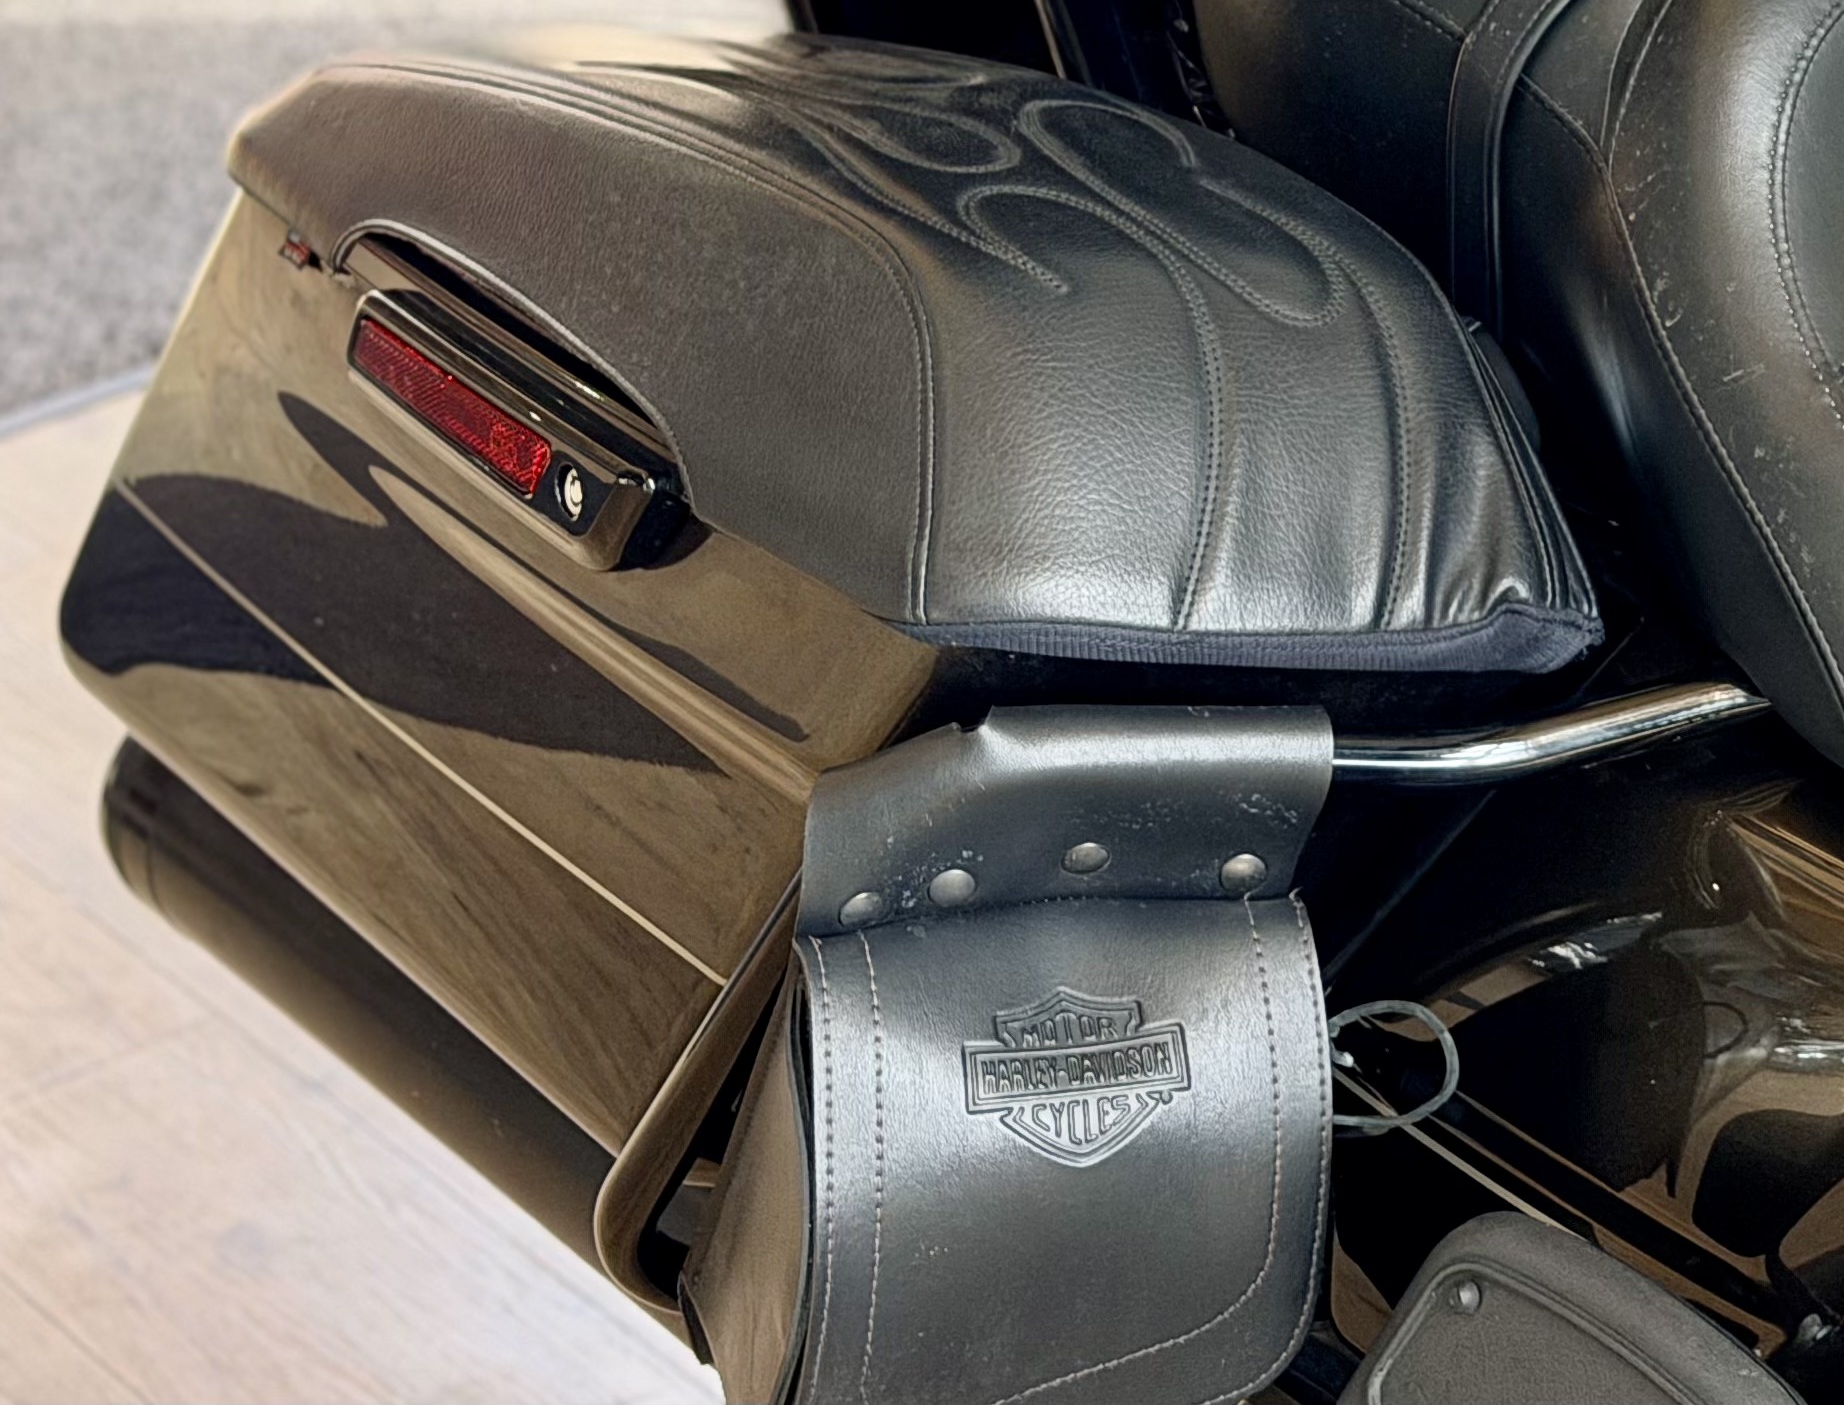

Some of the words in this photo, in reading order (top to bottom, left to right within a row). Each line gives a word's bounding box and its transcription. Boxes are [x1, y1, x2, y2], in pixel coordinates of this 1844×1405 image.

[1022, 1011, 1118, 1048] MOTOR
[980, 1040, 1172, 1095] HARLEY-DAVIDSON
[1031, 1094, 1131, 1145] CYCLES
